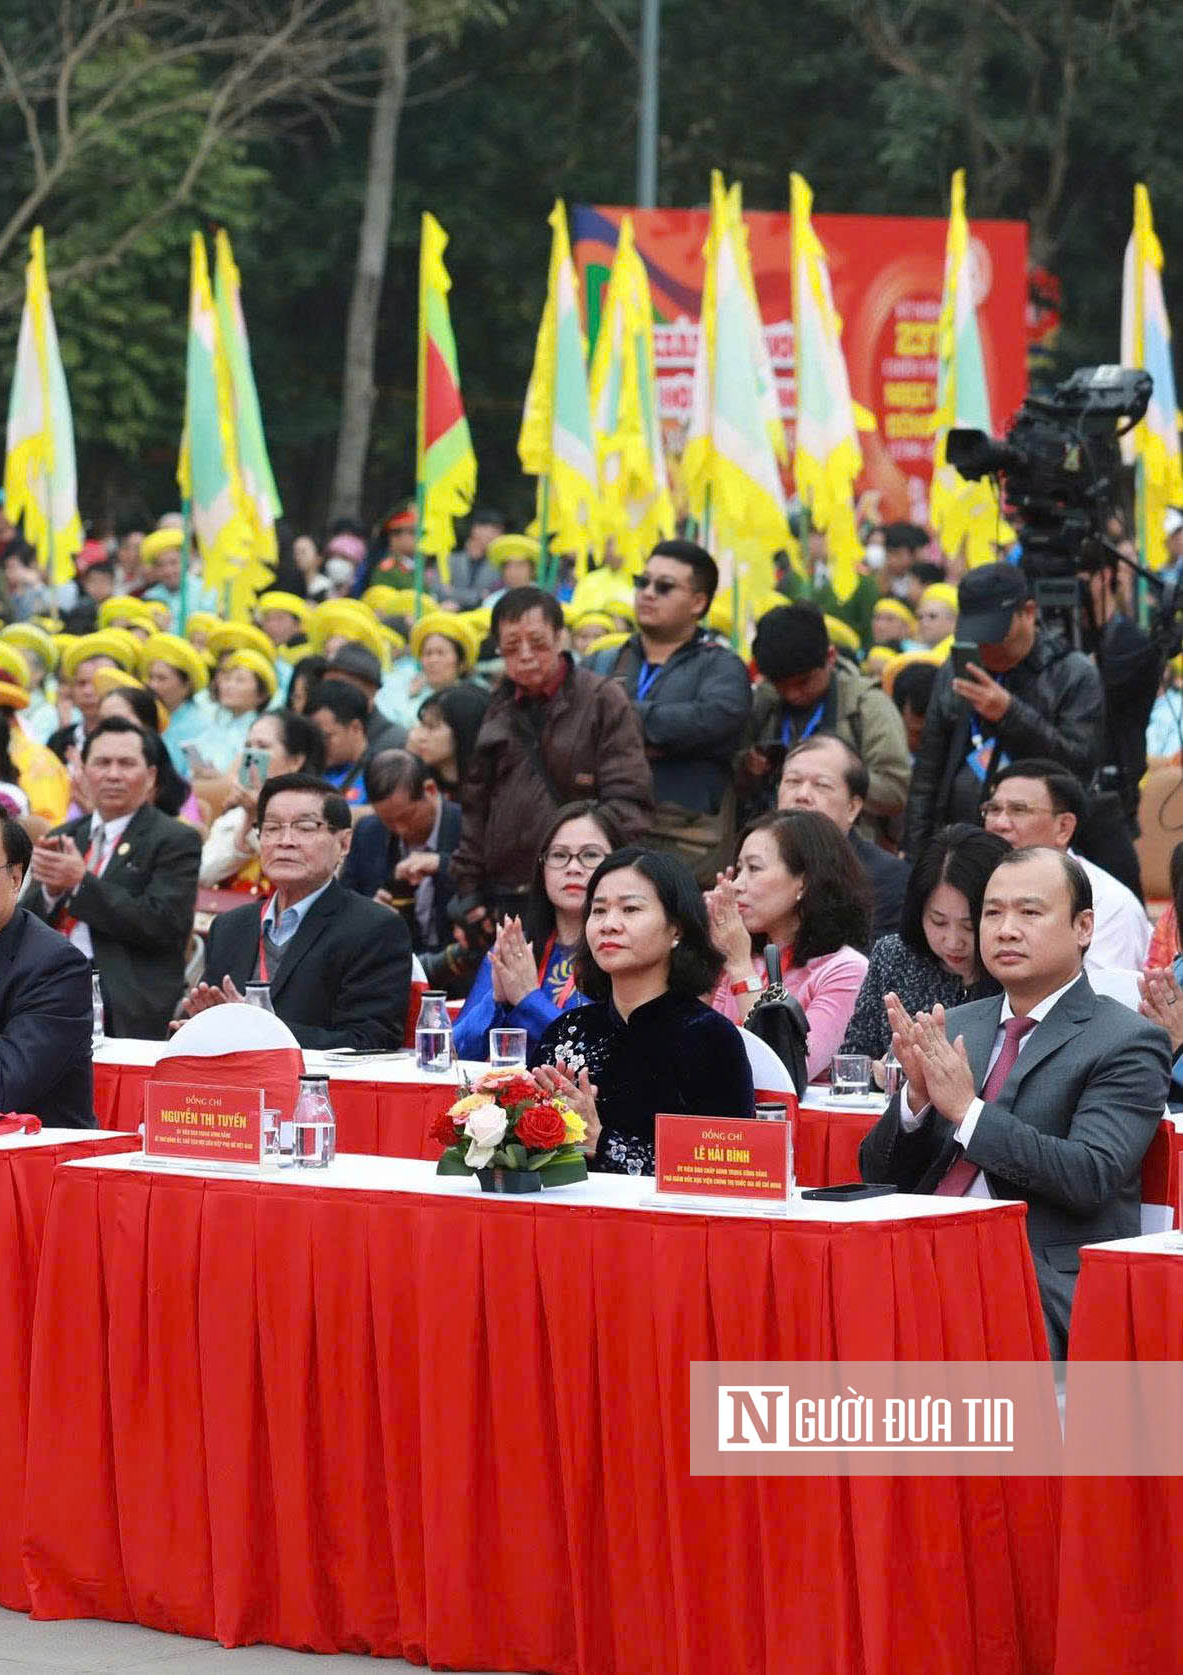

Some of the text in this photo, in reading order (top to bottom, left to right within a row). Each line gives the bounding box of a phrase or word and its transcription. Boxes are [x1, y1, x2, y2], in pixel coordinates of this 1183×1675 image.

[201, 1112, 215, 1128] THỊ
[727, 1131, 742, 1141] CHÍ
[694, 1145, 705, 1160] LÊ
